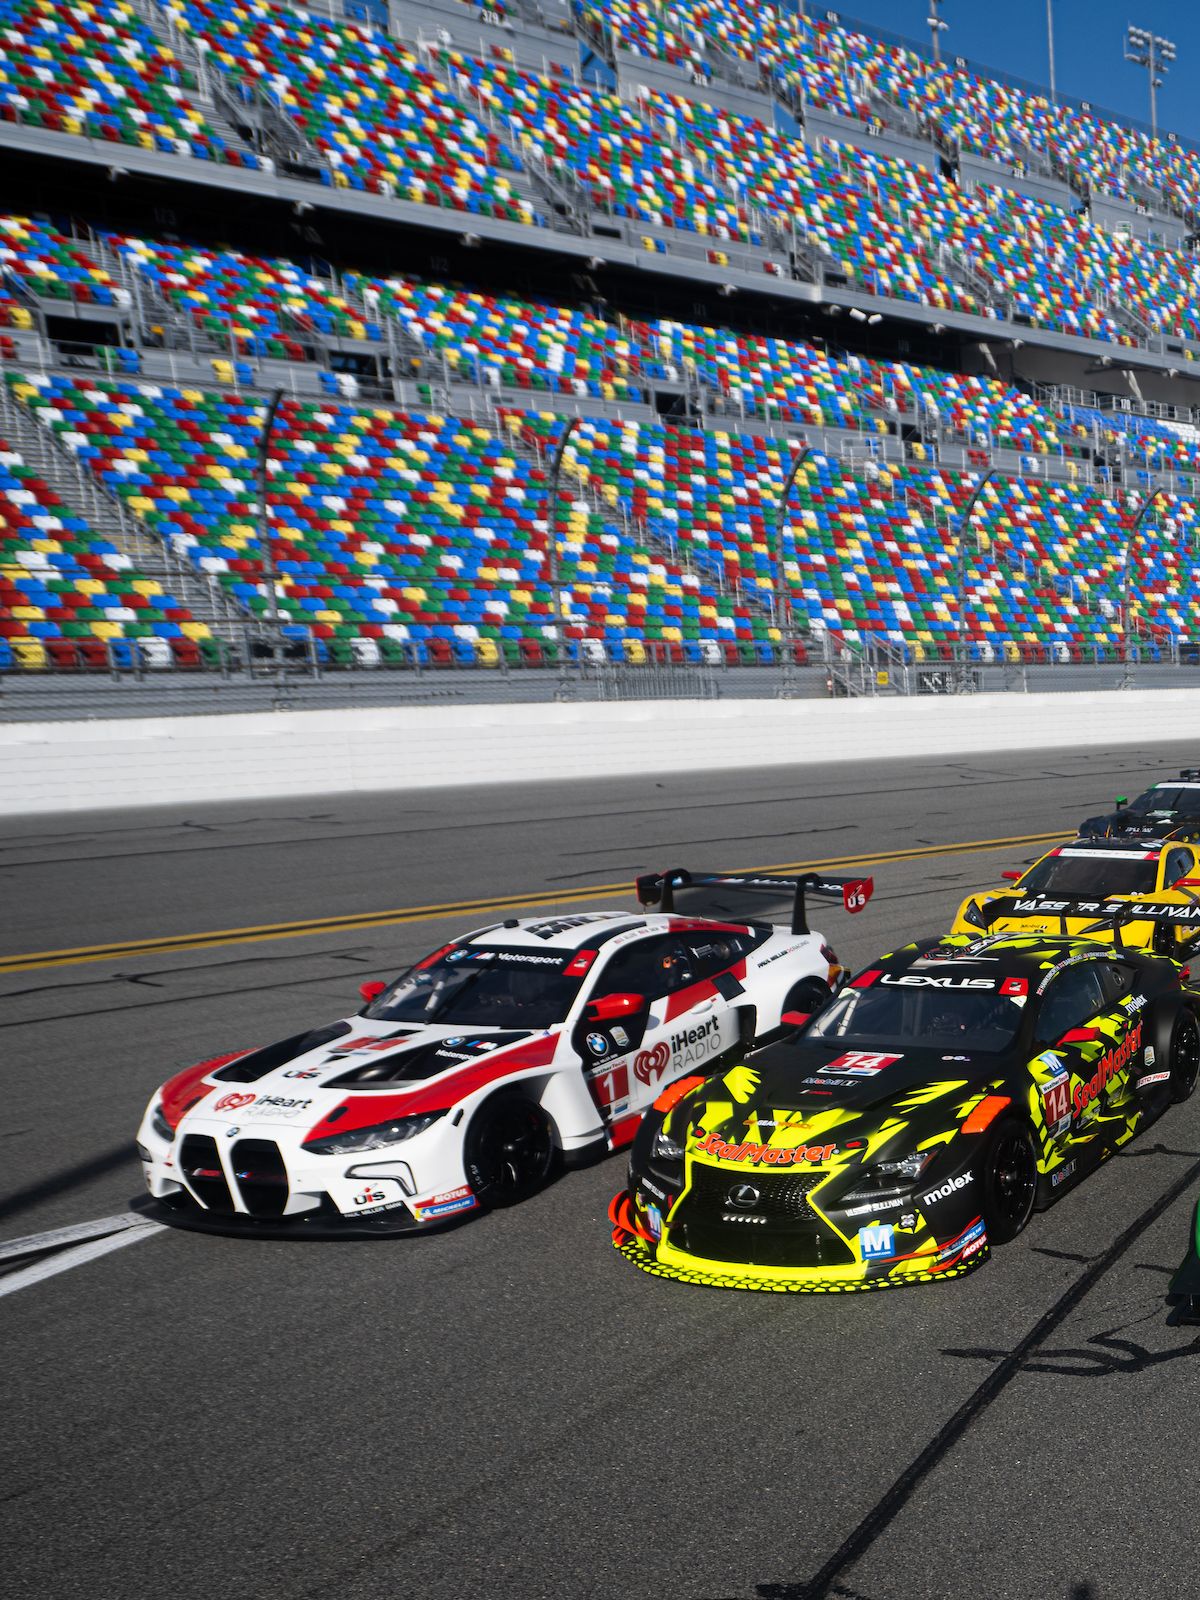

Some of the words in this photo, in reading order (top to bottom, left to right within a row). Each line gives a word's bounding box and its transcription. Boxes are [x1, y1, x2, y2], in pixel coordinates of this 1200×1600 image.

[1013, 899, 1100, 912] VASSR
[498, 953, 565, 965] Motorsport
[880, 974, 996, 989] LEXUS
[1125, 994, 1148, 1015] molex
[671, 1014, 720, 1054] iHeart
[673, 1033, 722, 1073] RADIO
[844, 1055, 881, 1069] 14
[1073, 1020, 1142, 1119] SealMaster
[603, 1072, 615, 1101] 1
[801, 1077, 842, 1086] Mobil
[255, 1094, 313, 1109] iHeart
[1049, 1084, 1068, 1121] 14
[696, 1132, 836, 1164] SealMaster
[433, 1188, 468, 1203] MOTUL
[923, 1170, 974, 1206] molex
[361, 1207, 385, 1216] MILLER
[386, 1202, 402, 1210] BMW
[432, 1199, 472, 1215] MICHELIN
[873, 1199, 904, 1212] SULLIVAN
[864, 1228, 891, 1252] M
